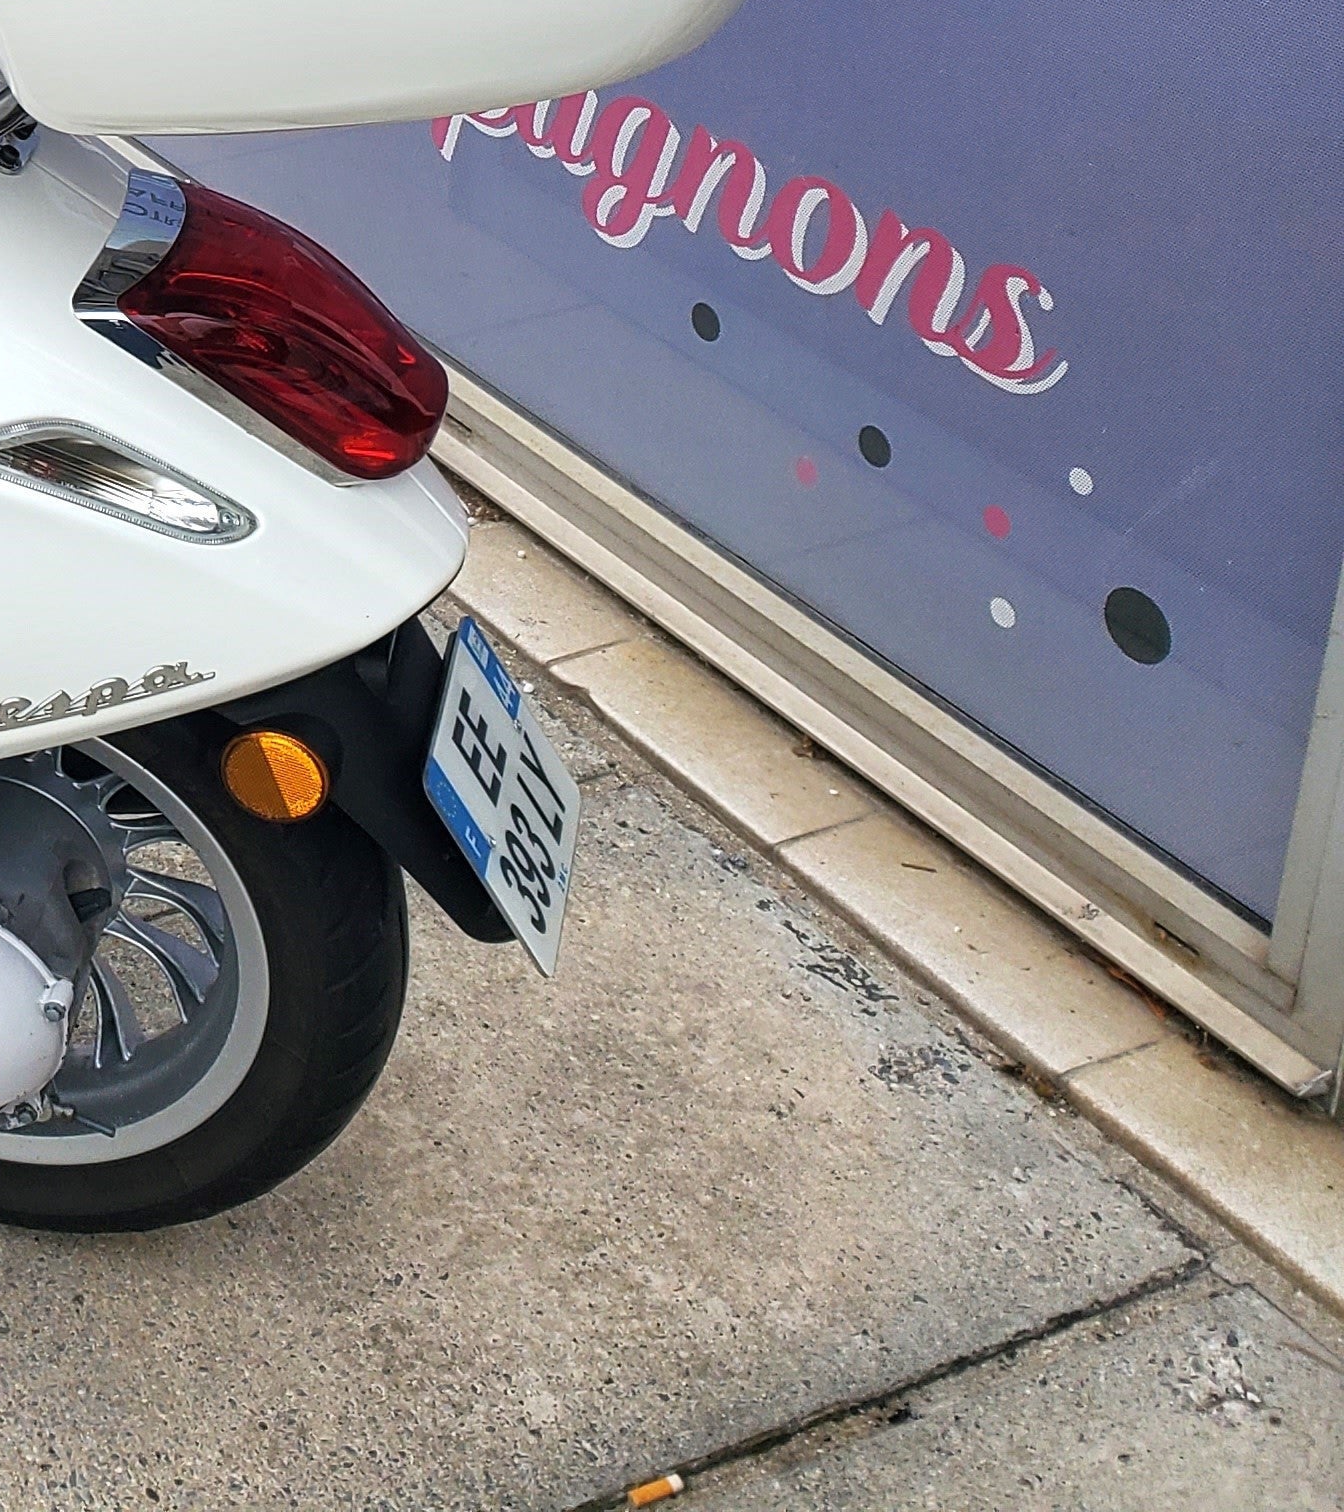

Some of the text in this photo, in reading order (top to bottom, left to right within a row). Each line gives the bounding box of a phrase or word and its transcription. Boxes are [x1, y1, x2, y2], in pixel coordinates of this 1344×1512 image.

[452, 686, 507, 808] EE
[464, 825, 482, 859] F
[499, 731, 566, 935] 393 LY
